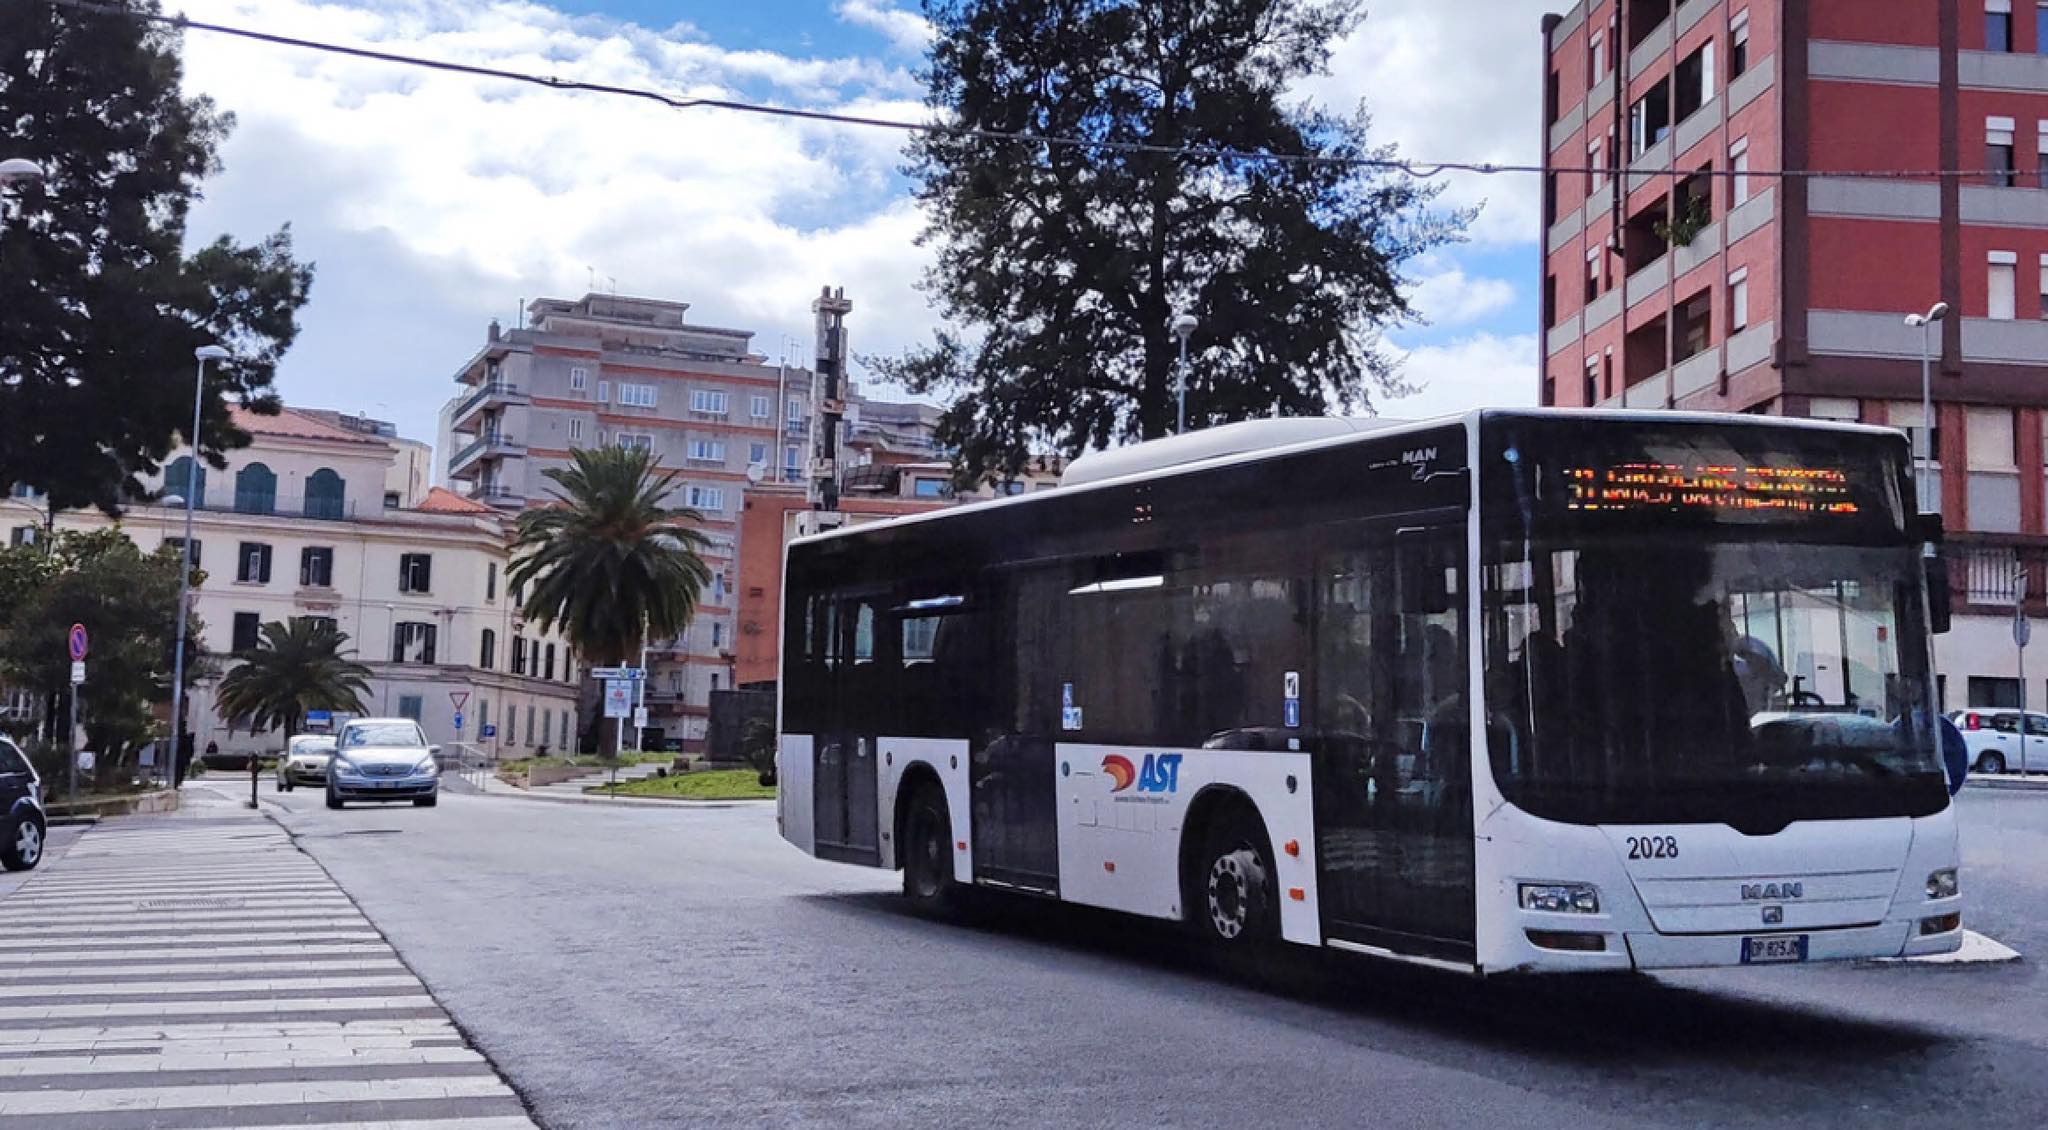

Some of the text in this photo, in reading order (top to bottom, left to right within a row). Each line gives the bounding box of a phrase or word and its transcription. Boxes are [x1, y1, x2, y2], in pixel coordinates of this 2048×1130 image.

[1402, 447, 1437, 464] MAN
[1137, 753, 1183, 792] AST
[1626, 835, 1679, 860] 2028
[1741, 882, 1803, 900] MAN
